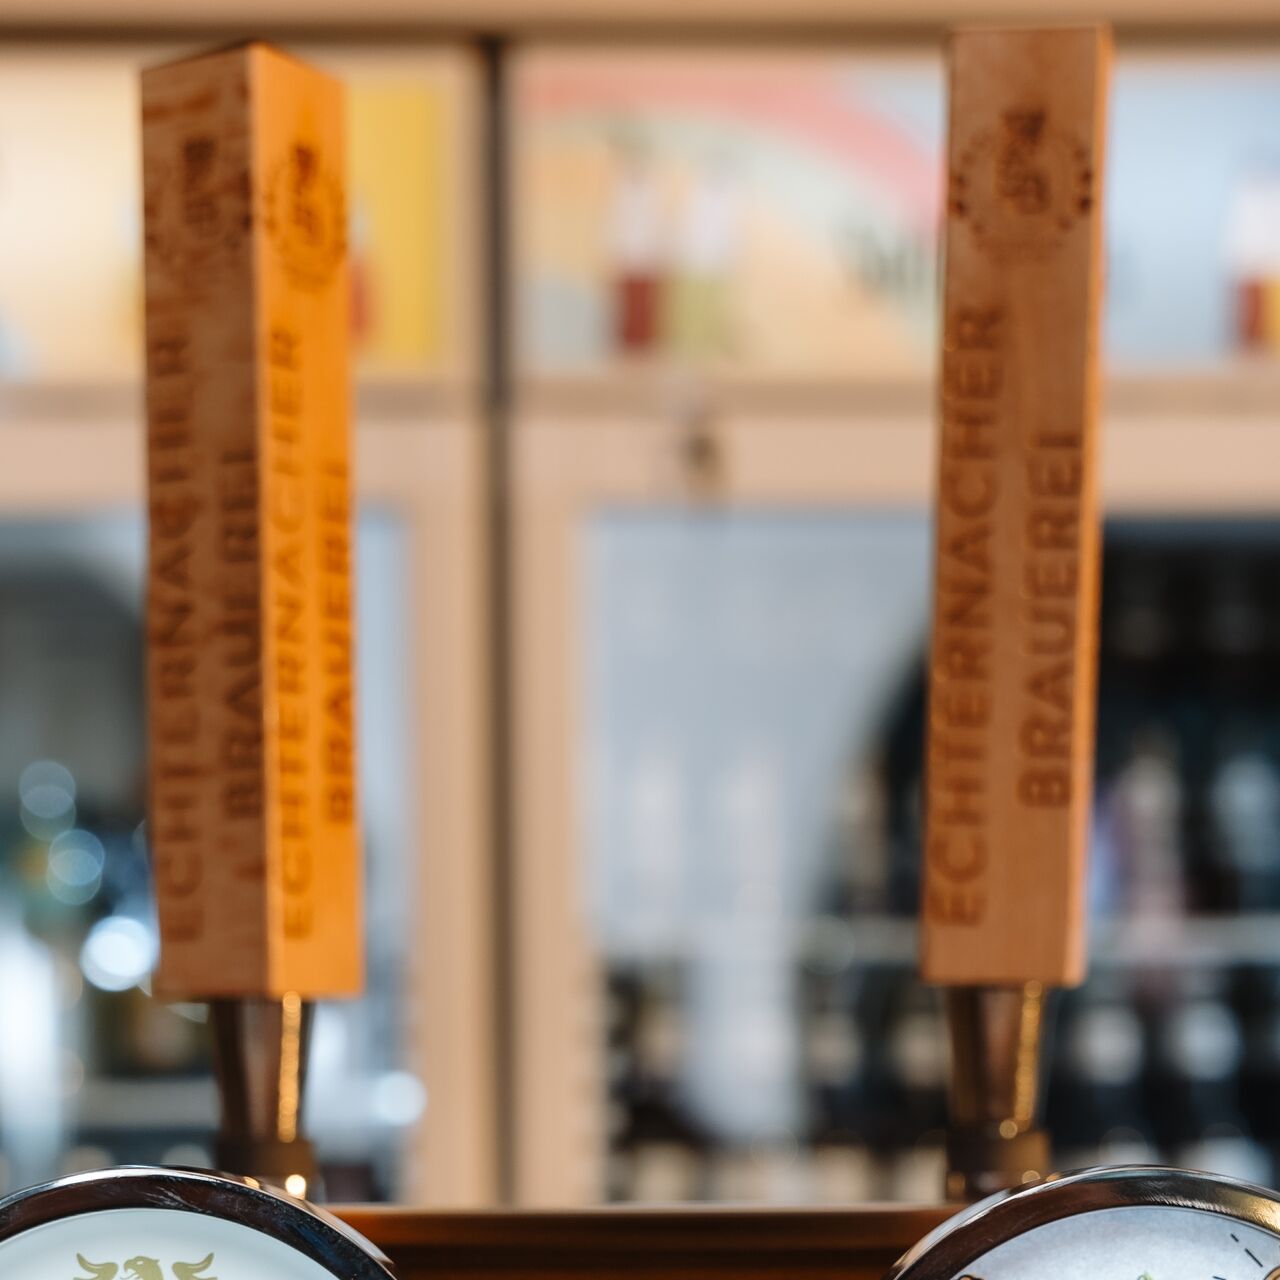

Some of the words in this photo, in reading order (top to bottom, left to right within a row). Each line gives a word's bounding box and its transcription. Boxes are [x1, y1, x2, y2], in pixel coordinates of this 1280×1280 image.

[221, 450, 267, 819] BRAUEREI
[271, 328, 313, 940] ECHTERNACHER
[321, 462, 355, 824] BRAUEREI
[925, 306, 1003, 928] ECHTERNACHER
[1019, 433, 1082, 808] BRAUEREI
